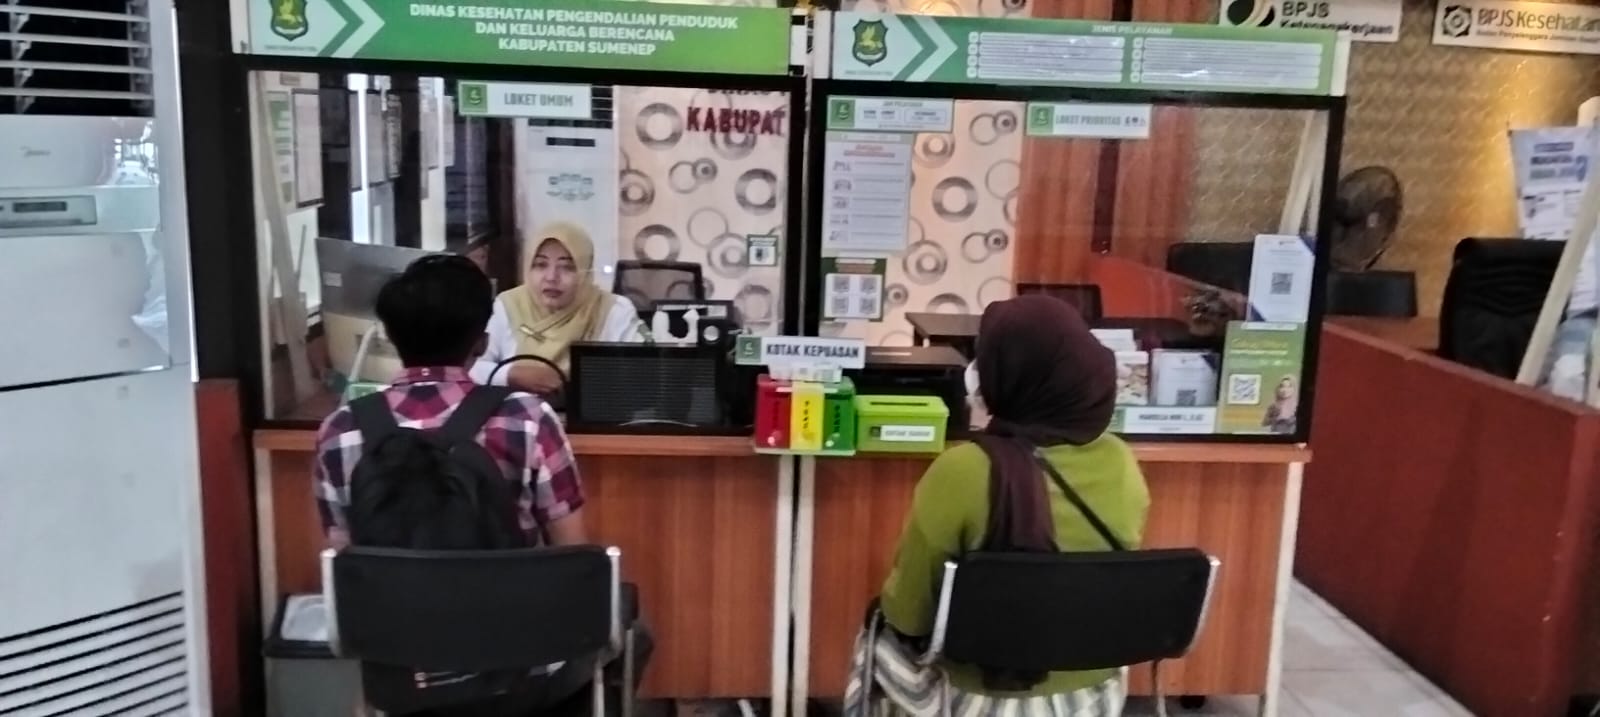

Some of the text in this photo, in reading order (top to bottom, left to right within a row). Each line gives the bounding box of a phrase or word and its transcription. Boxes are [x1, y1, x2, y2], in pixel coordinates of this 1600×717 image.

[410, 4, 739, 29] DINAS KESEHATAN PENGENDALIAN PENDUDUK
[1281, 1, 1330, 18] BPJS
[1477, 8, 1514, 27] BPJS
[475, 21, 675, 41] DAN KELUARGA BERENCANA
[1117, 25, 1174, 36] PELAYANAN
[498, 37, 656, 55] KABUPATEN SUMENEP
[504, 93, 574, 107] LOKET UMUM
[766, 344, 860, 358] KOTAK KEPUASAN
